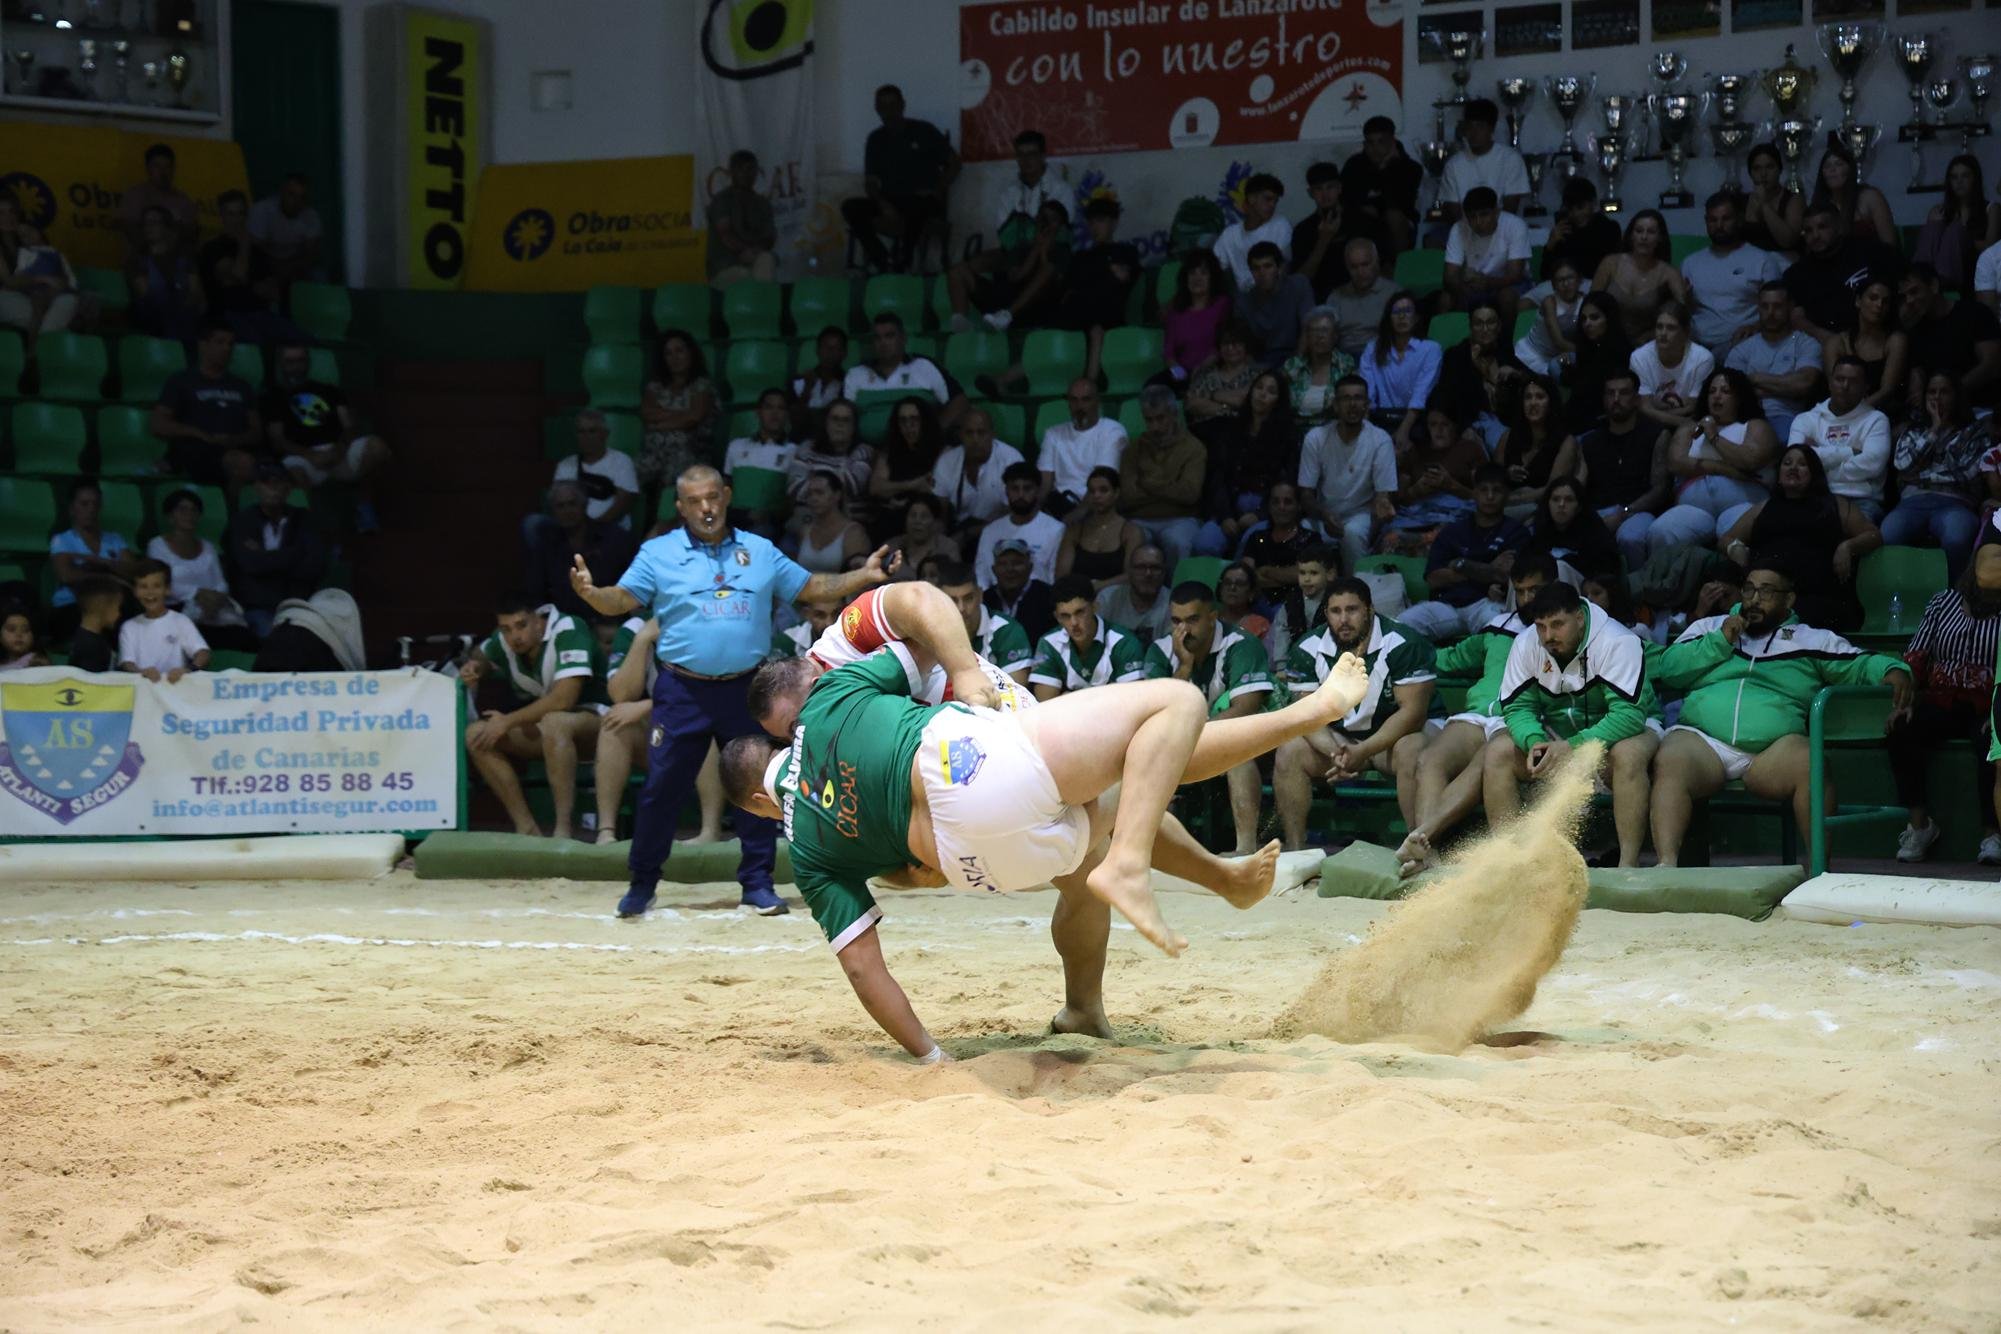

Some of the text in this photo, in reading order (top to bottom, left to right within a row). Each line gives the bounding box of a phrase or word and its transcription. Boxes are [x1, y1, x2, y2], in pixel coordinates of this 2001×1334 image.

[990, 11, 1078, 36] Cabildo
[1086, 2, 1170, 28] Insular
[1179, 0, 1209, 21] de
[1005, 14, 1341, 86] con lo nuestro
[425, 36, 464, 279] NETTO
[703, 600, 751, 615] CICAR
[212, 675, 380, 701] Empresa de
[43, 719, 94, 748] AS
[161, 709, 431, 740] Seguridad Privada
[212, 748, 381, 770] de Canarias
[70, 769, 130, 814] SEGUR
[190, 772, 414, 795] Tlf.:928 85 88 45
[152, 797, 438, 818] info@atlantisegur.com
